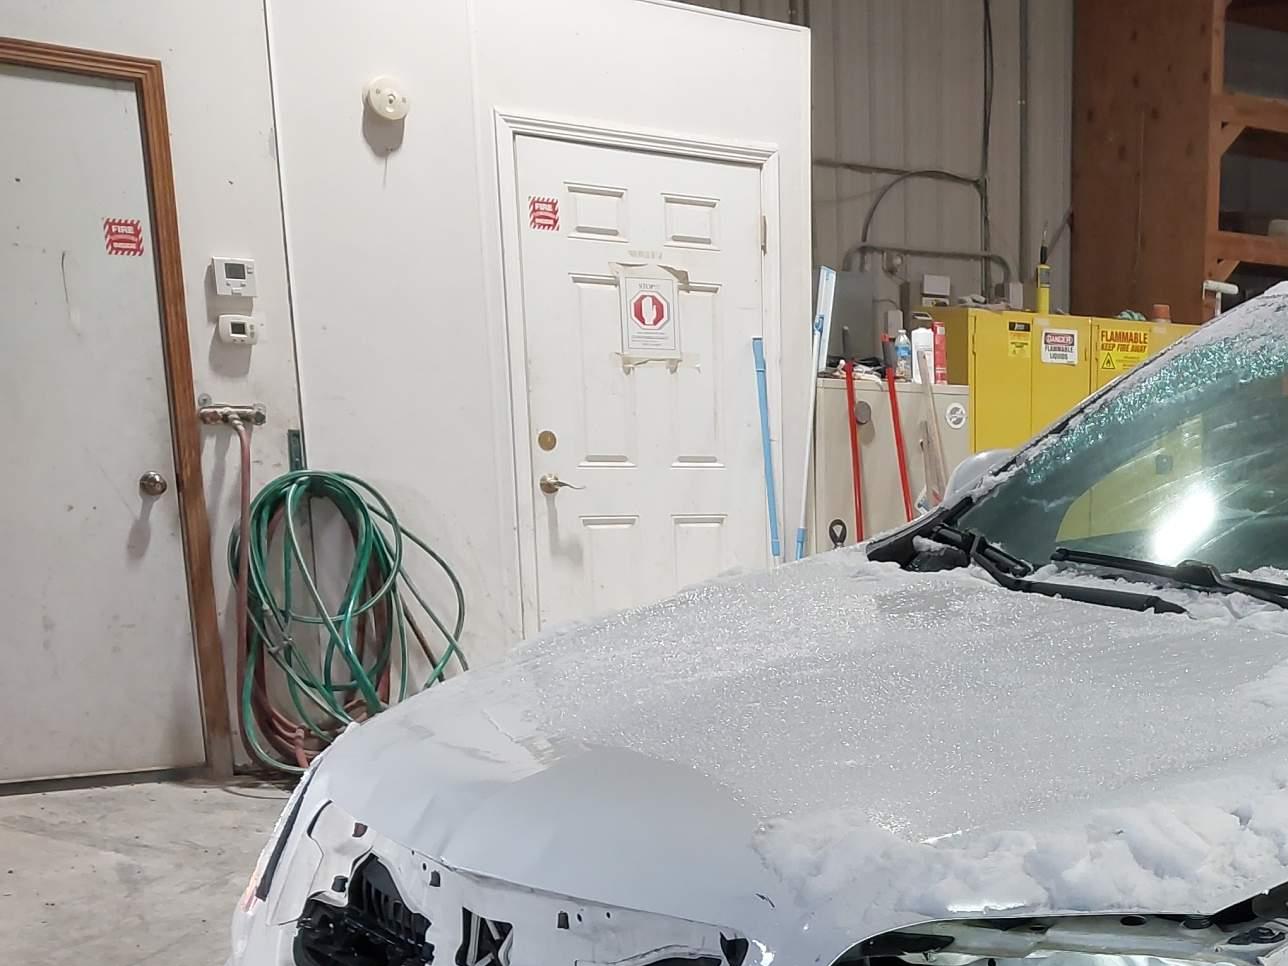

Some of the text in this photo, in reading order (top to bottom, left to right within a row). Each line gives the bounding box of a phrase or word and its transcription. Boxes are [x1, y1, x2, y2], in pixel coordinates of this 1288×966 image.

[111, 225, 135, 234] FIRE
[1047, 335, 1073, 345] DANGER
[1101, 330, 1148, 344] FLAMMABLE
[1044, 345, 1073, 353] FLAMMABLE
[1101, 343, 1147, 353] KEEP FIRE AWAY
